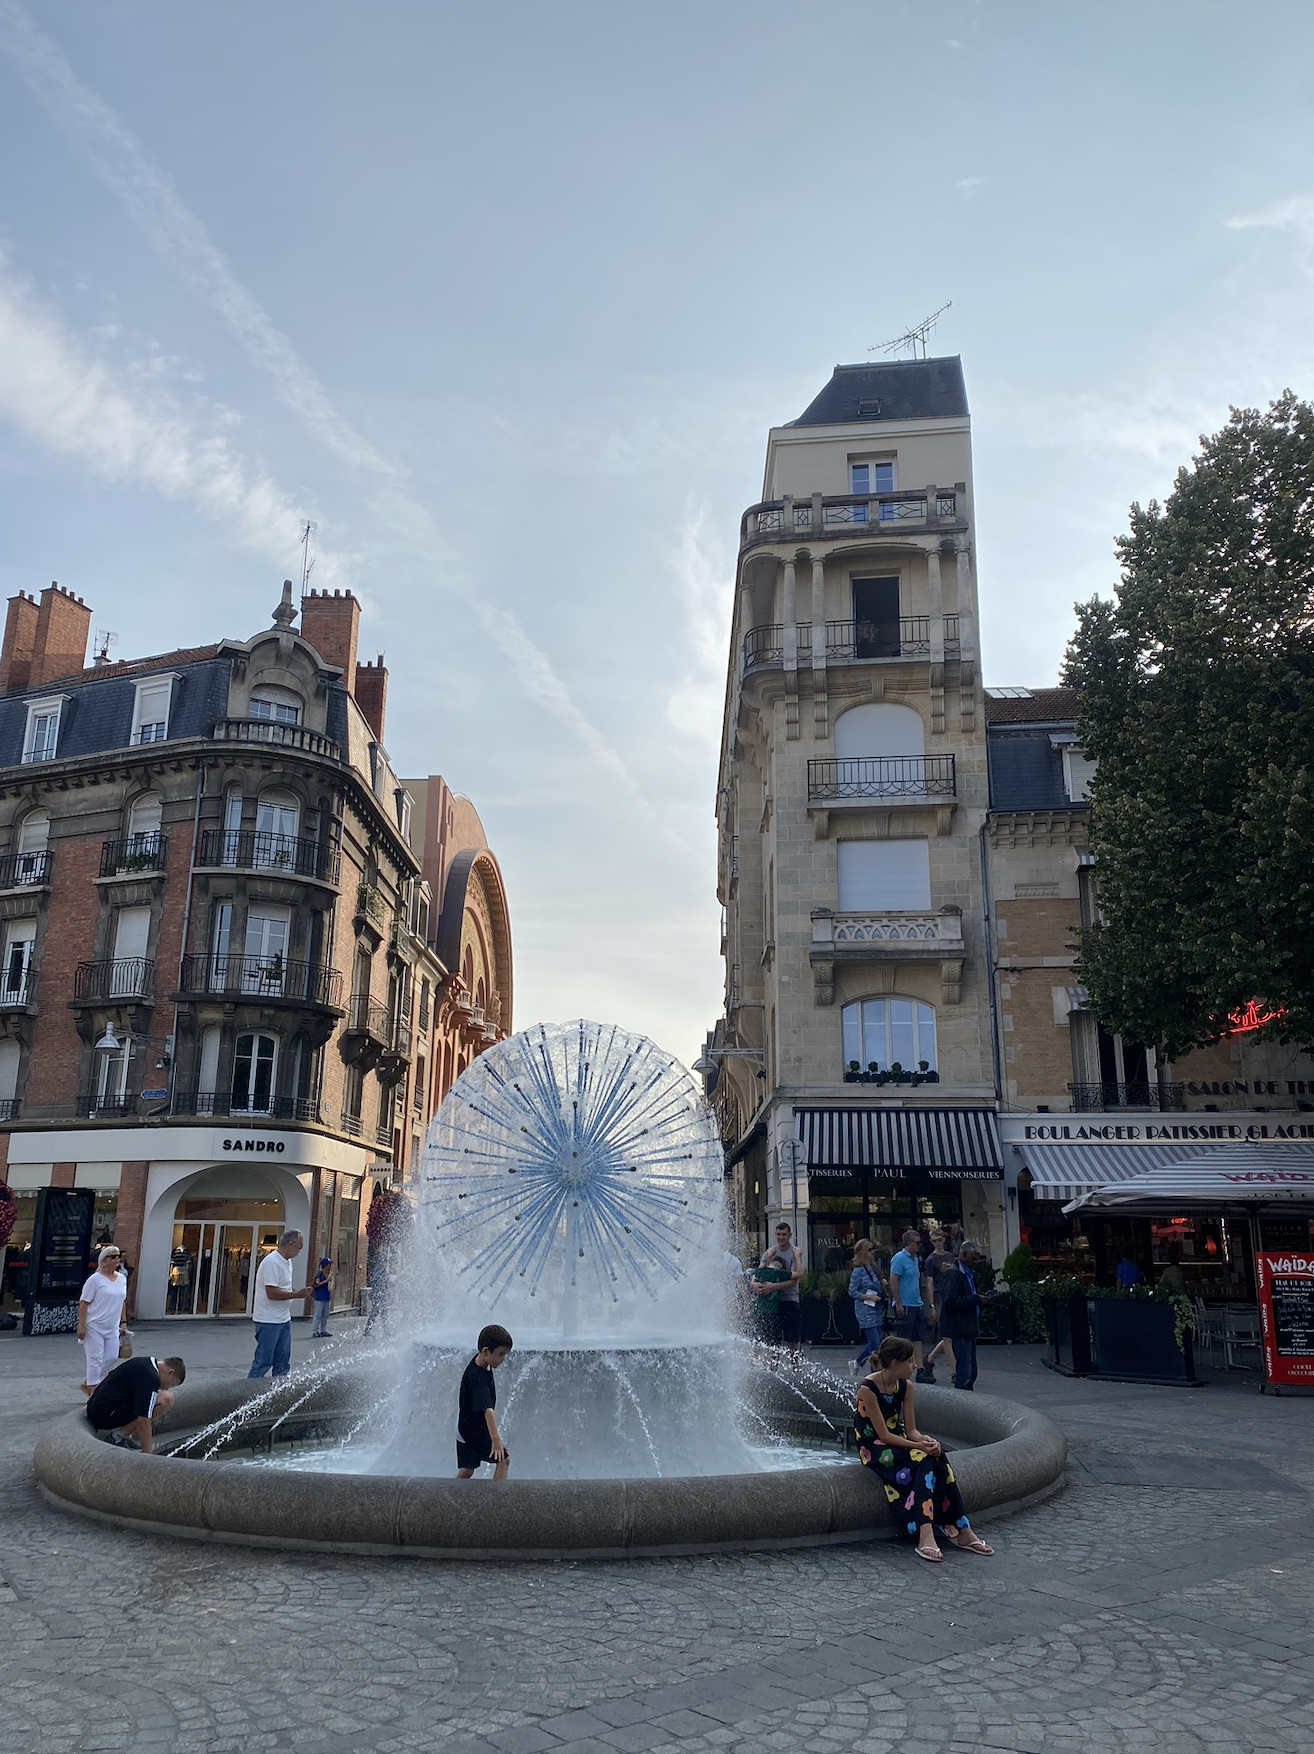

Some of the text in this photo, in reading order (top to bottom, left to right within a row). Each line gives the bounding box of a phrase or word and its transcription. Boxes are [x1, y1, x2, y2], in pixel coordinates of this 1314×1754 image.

[1187, 1081, 1249, 1096] SALON
[1254, 1081, 1279, 1095] DE
[1024, 1125, 1141, 1140] BOULANGER
[1145, 1125, 1242, 1140] PATISSIER
[222, 1139, 286, 1153] SANDRO
[873, 1167, 908, 1178] PAUL
[928, 1170, 1000, 1180] VIENNOISERIES
